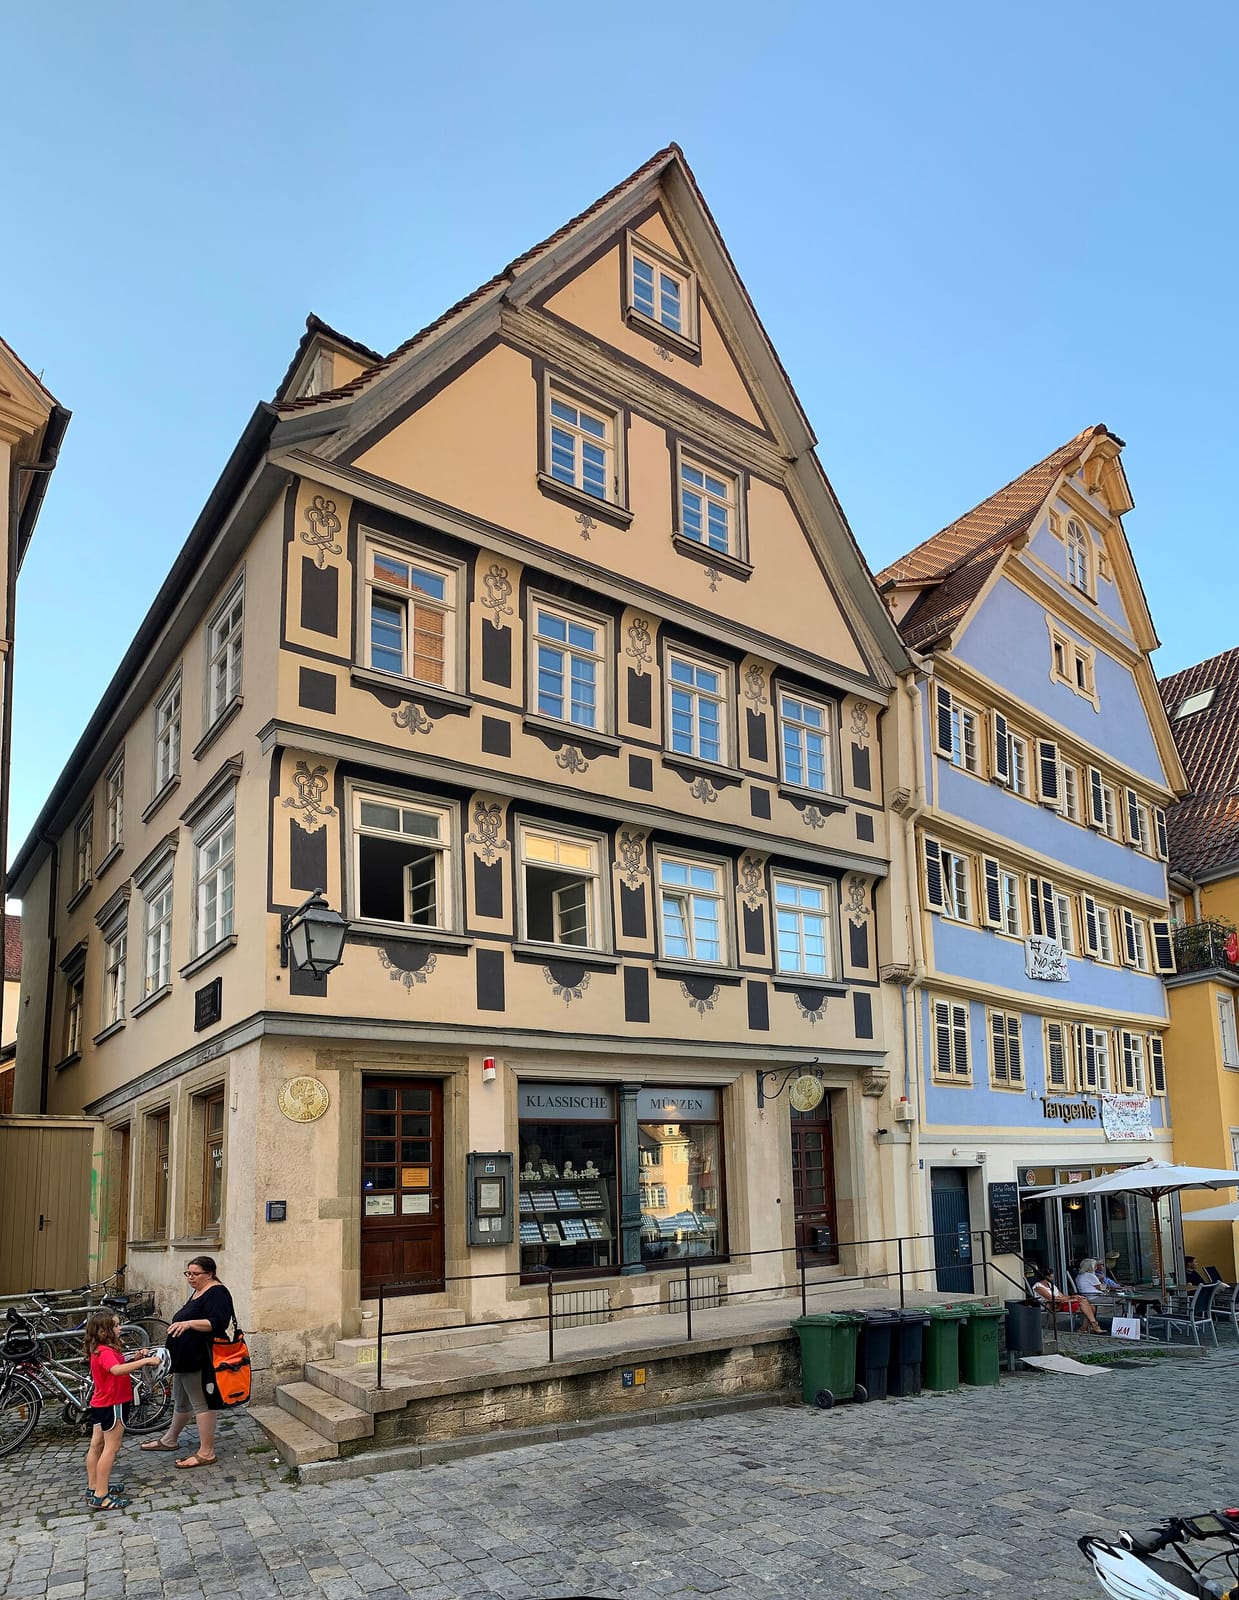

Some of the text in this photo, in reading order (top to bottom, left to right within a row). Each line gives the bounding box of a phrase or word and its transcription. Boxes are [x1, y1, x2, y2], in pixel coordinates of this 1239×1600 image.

[526, 1095, 703, 1110] KLASSISCHE MÜNZEN
[1040, 1096, 1097, 1124] Tangente
